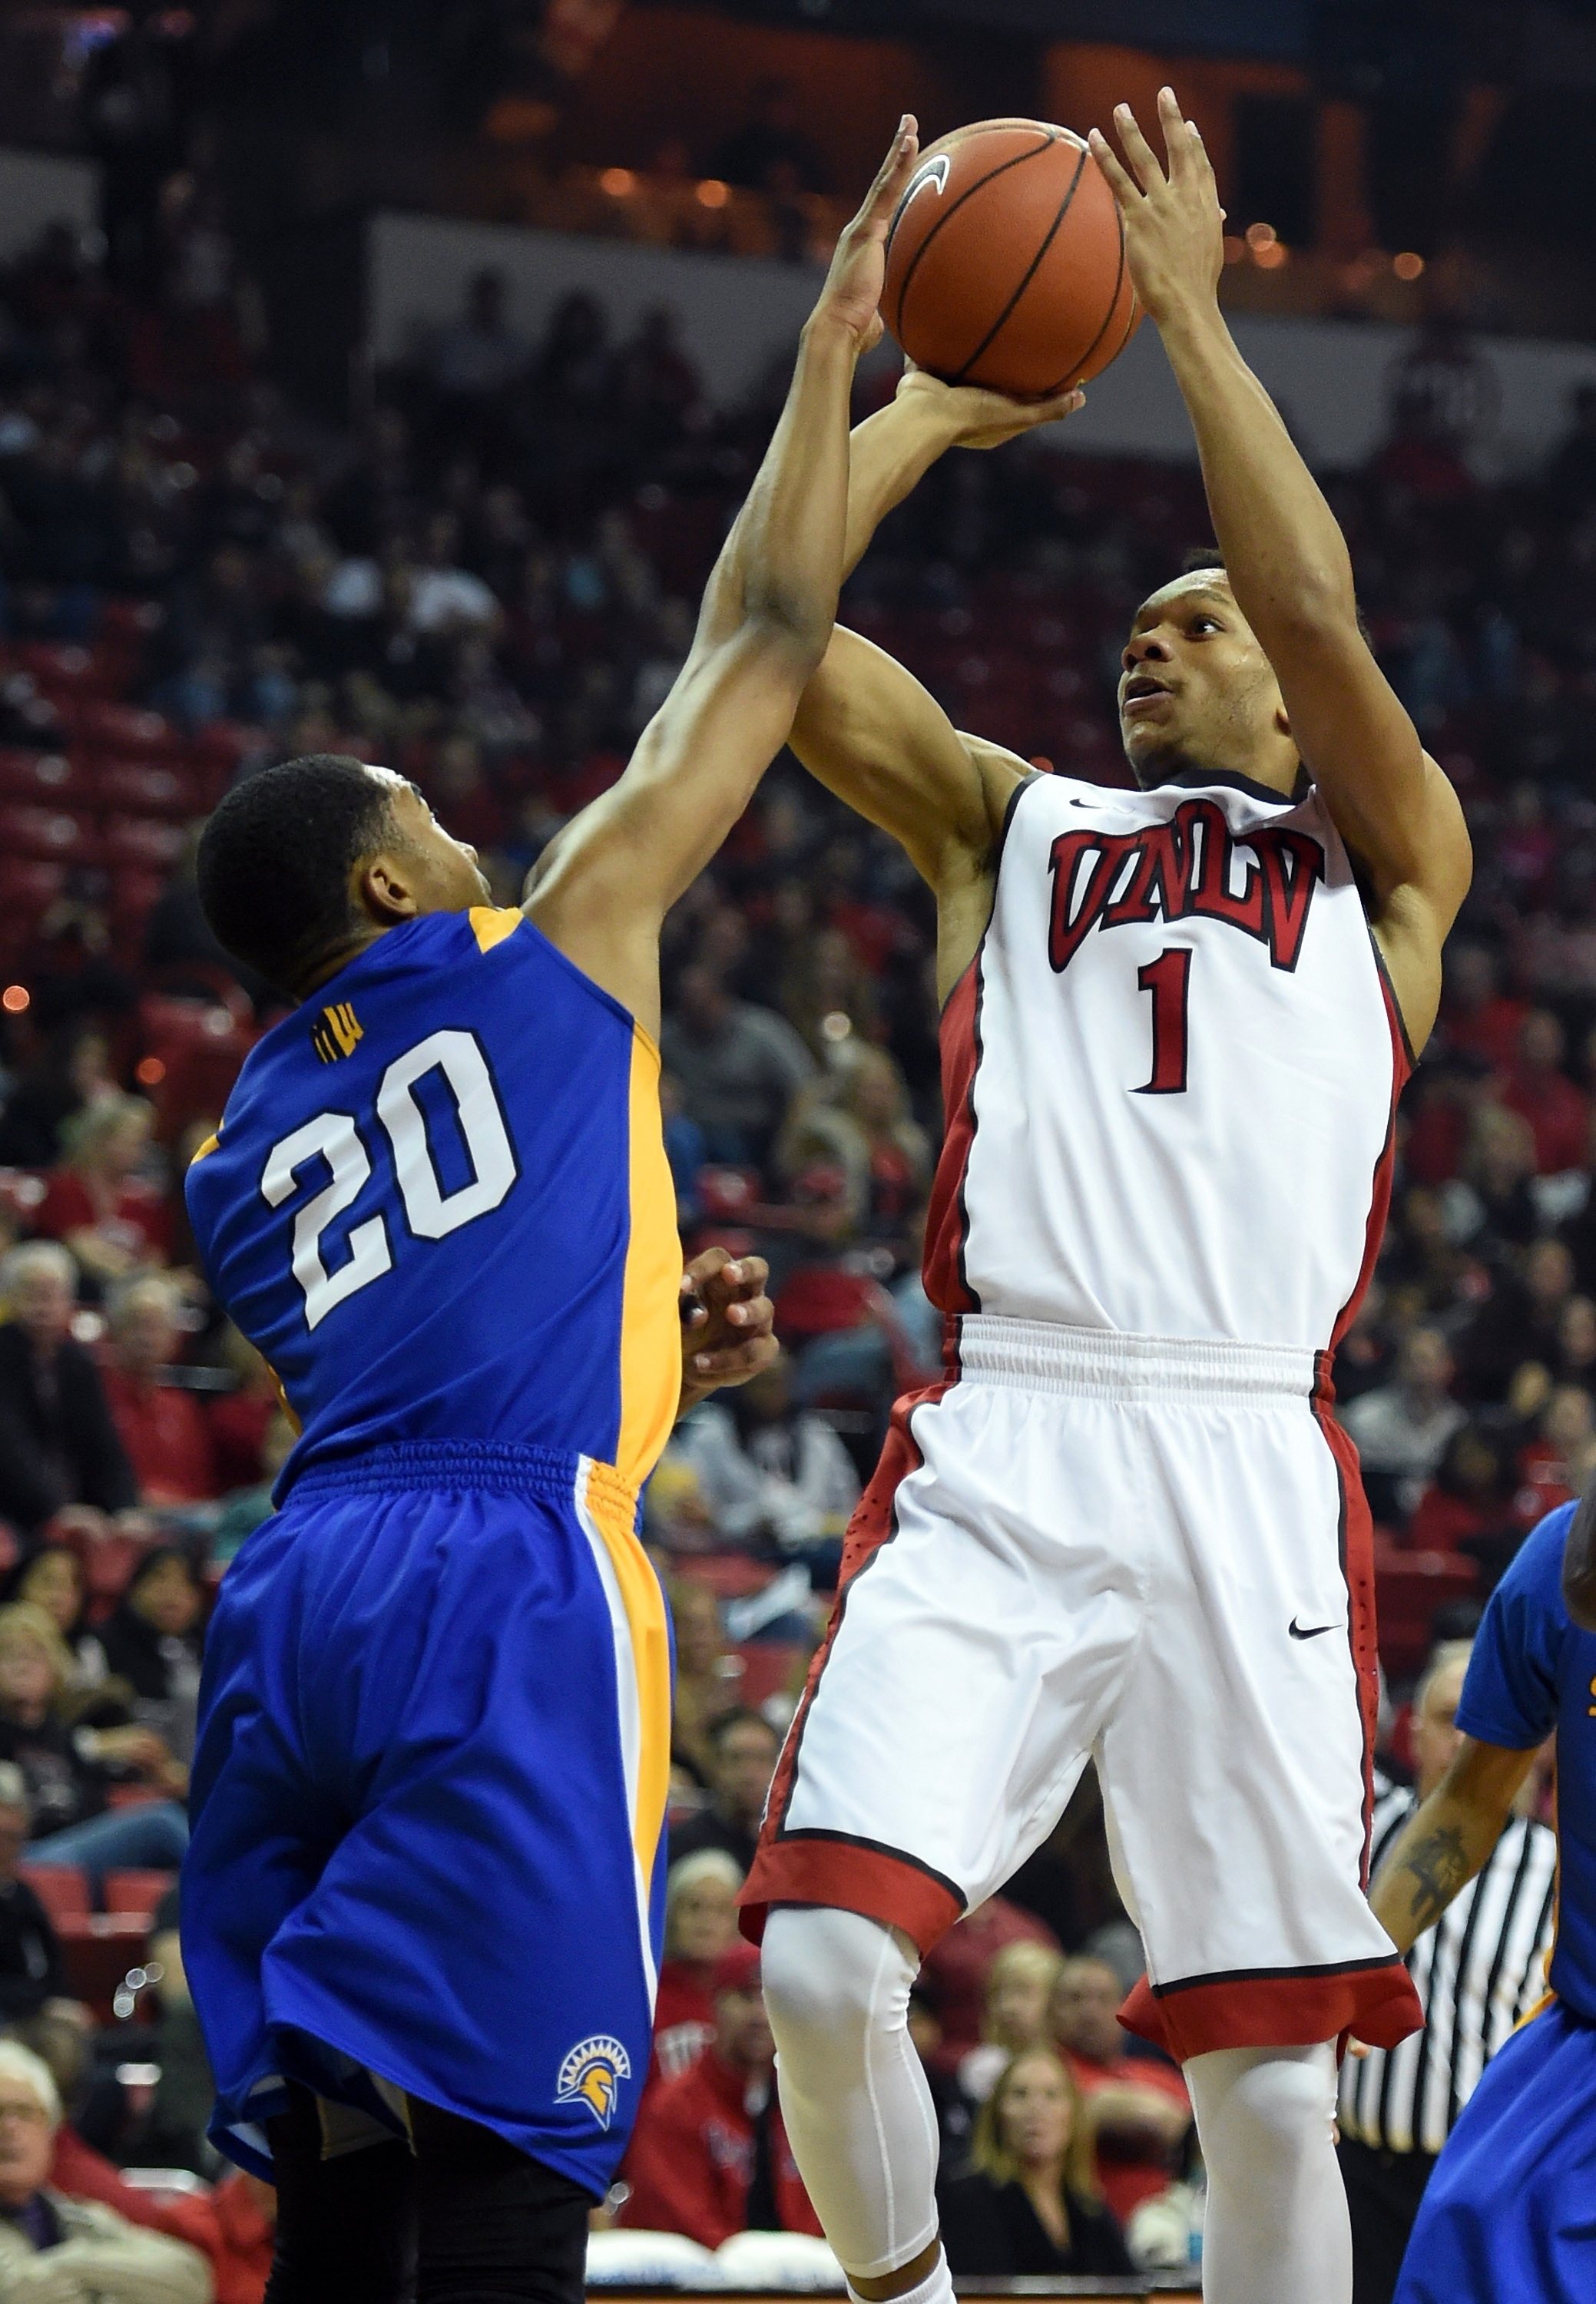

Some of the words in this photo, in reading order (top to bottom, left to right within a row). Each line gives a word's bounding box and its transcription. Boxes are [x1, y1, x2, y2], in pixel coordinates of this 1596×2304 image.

[1048, 799, 1326, 974] UNLV
[1127, 948, 1193, 1094] 1
[260, 1027, 521, 1332] 20
